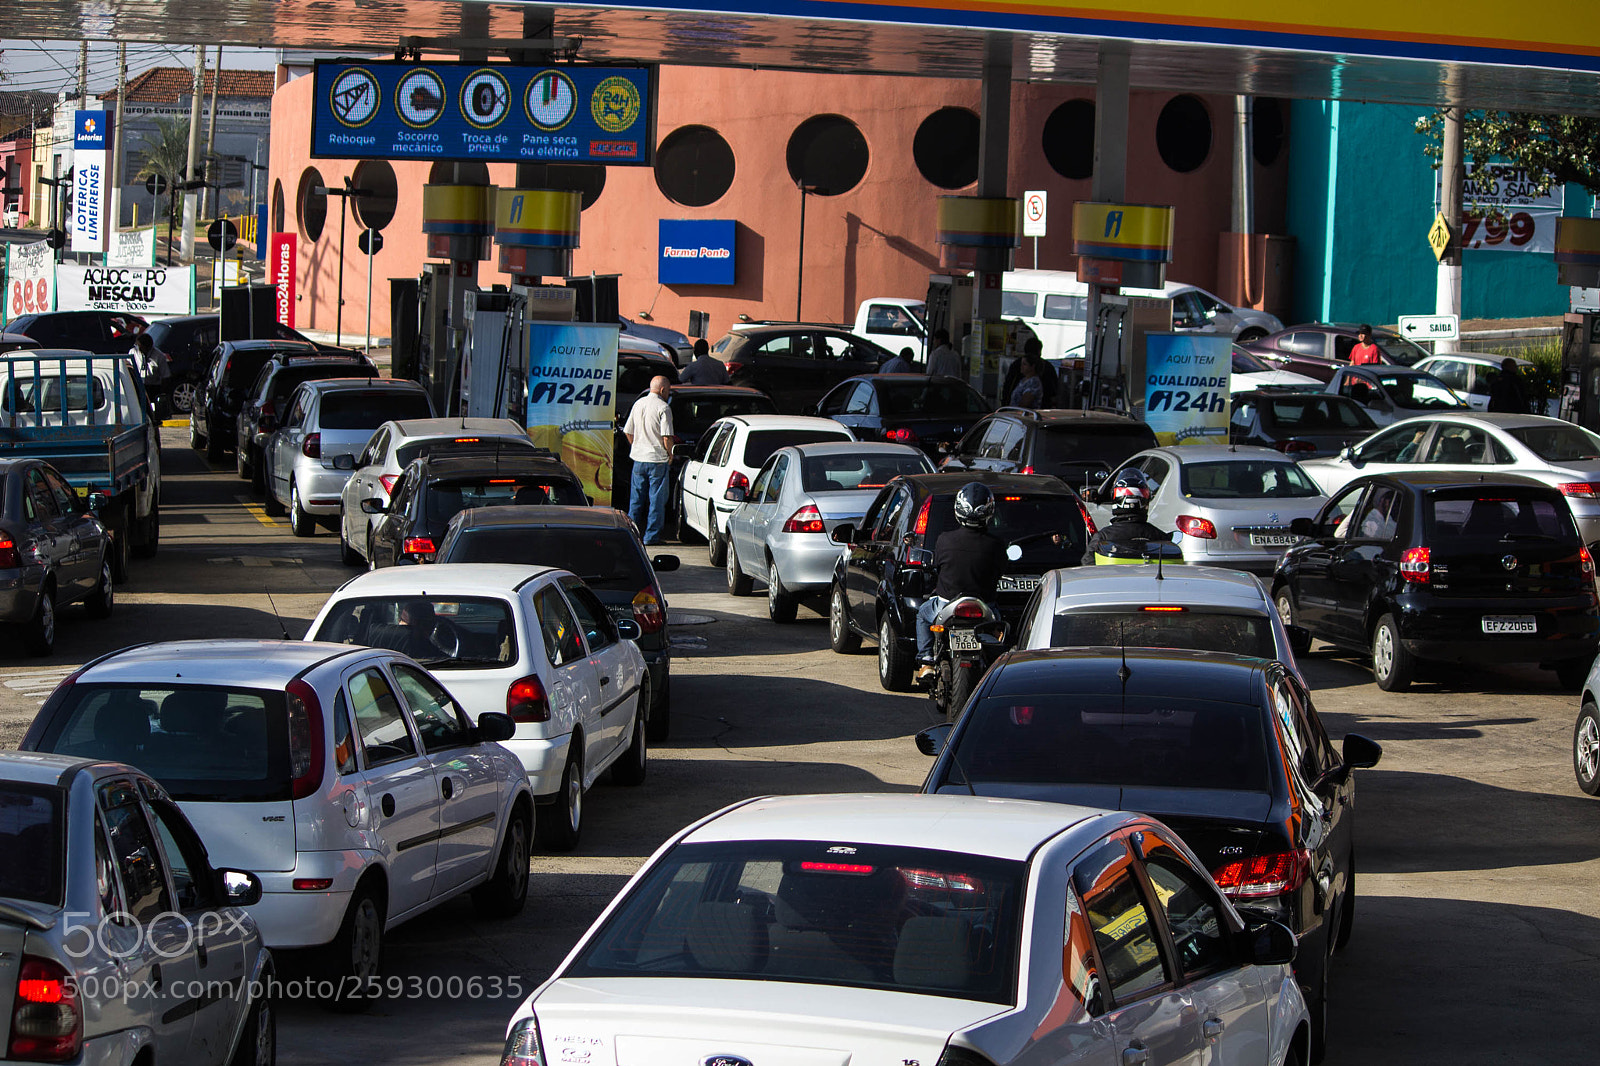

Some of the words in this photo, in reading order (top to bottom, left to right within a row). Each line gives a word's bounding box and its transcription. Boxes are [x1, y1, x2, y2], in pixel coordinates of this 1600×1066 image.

[77, 133, 103, 142] Loterias
[329, 134, 376, 146] Reboque
[398, 131, 439, 141] Socorro
[462, 133, 492, 143] Troca
[494, 134, 508, 144] de
[523, 134, 549, 145] Pane
[552, 136, 578, 145] seca
[468, 143, 500, 153] pneus
[520, 148, 534, 156] ou
[88, 164, 100, 241] LIMEIRENSE
[663, 246, 698, 257] Farma
[699, 247, 730, 258] Ponte
[83, 269, 131, 285] ACHOC.
[88, 286, 156, 302] NESCAU
[93, 302, 119, 310] SACHET
[550, 346, 576, 355] AQUI
[579, 347, 600, 356] TEM
[1166, 354, 1191, 363] AQUI
[1194, 356, 1215, 364] TEM
[531, 366, 613, 381] QUALIDADE
[1148, 374, 1227, 388] QUALIDADE
